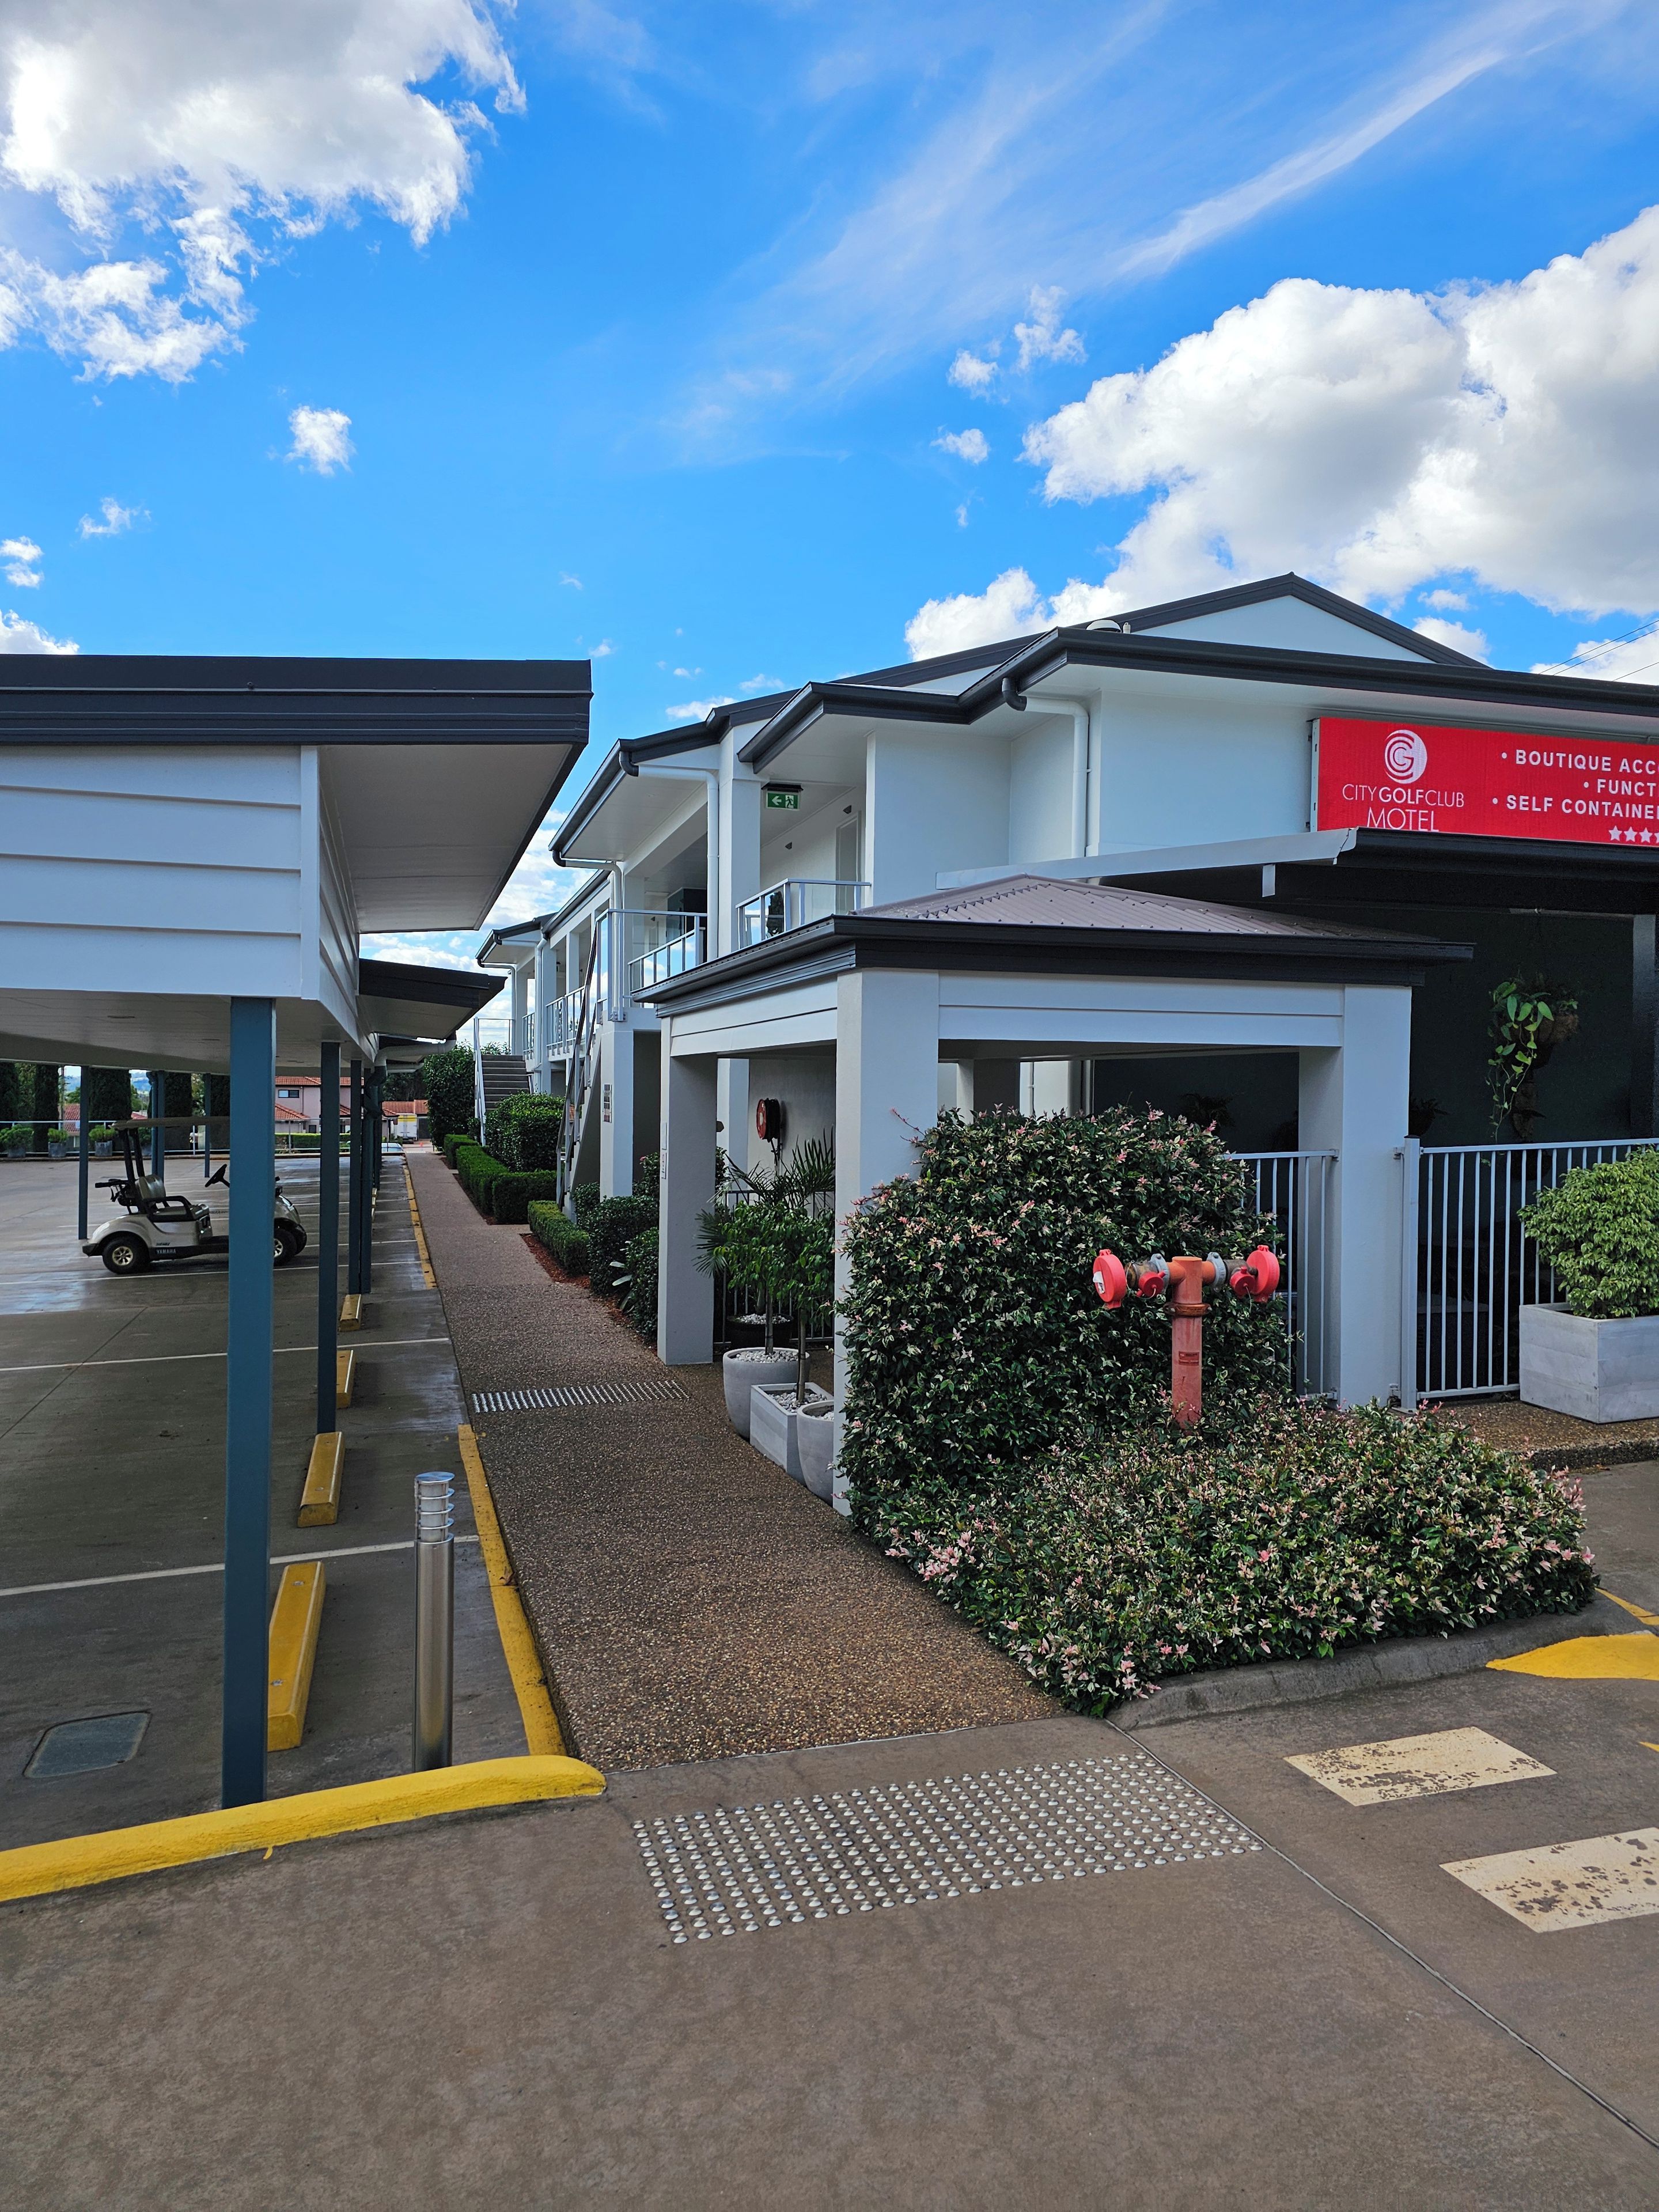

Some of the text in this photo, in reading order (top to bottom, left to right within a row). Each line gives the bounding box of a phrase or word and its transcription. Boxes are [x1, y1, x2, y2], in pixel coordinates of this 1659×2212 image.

[1516, 749, 1659, 774] BOUTIQUE ACC
[1597, 779, 1657, 797] FUNCT
[1367, 807, 1439, 832] MOTEL
[1507, 795, 1659, 820] SELF CONTAINE
